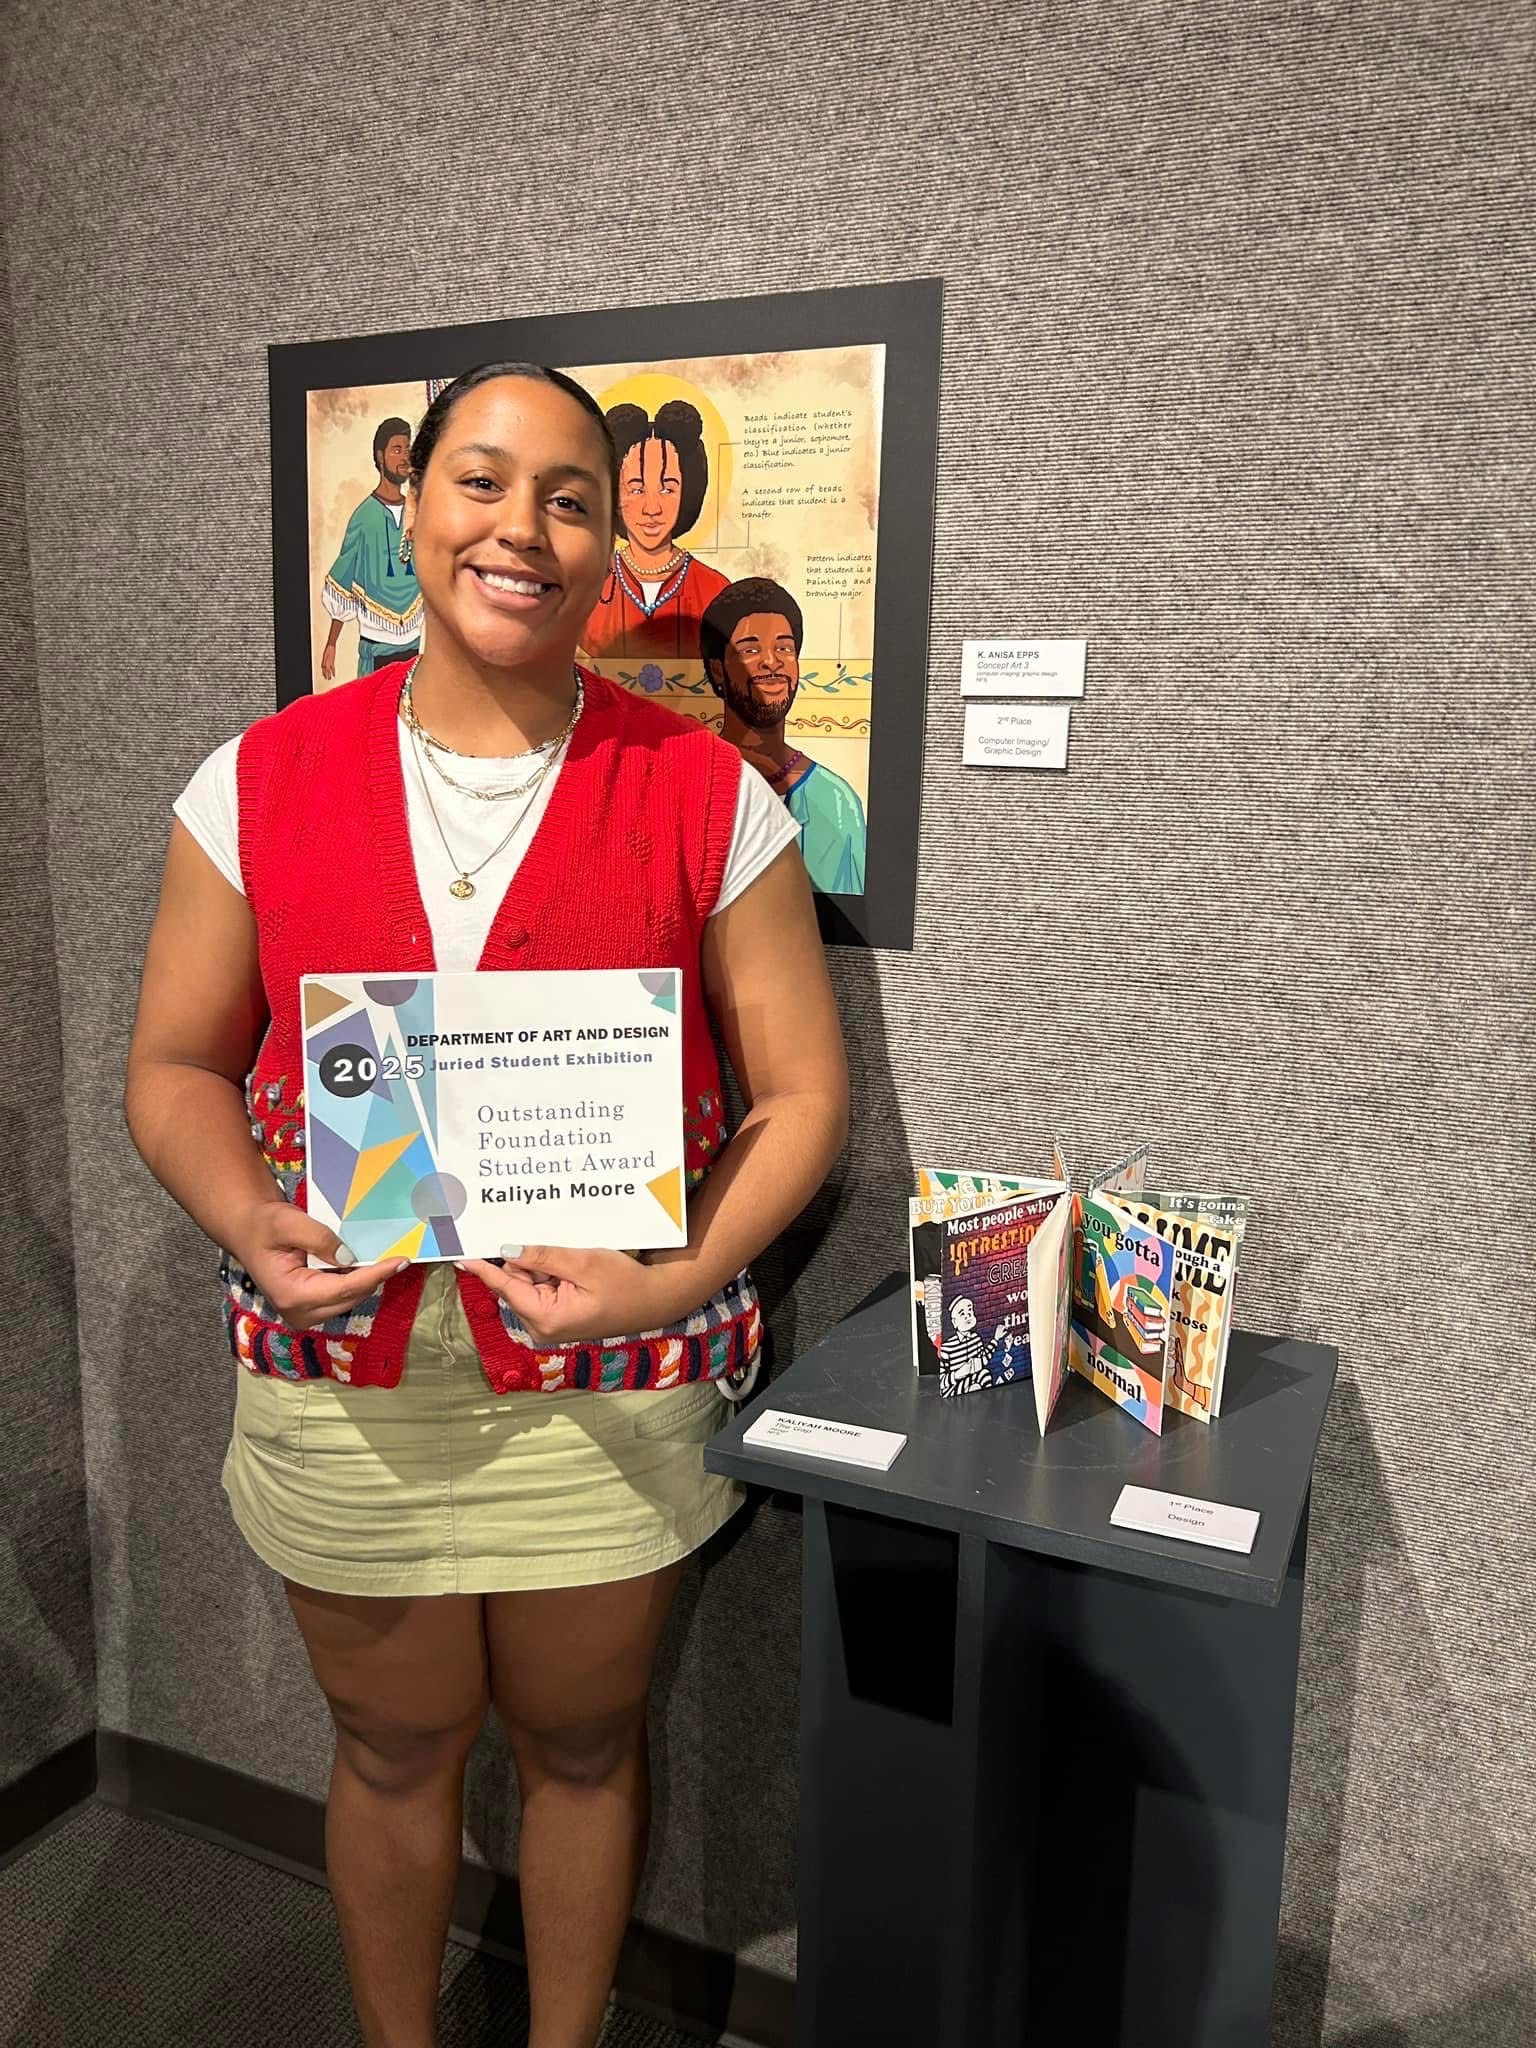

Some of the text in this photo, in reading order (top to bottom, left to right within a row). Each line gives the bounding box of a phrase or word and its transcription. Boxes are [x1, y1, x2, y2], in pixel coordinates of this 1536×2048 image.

[744, 409, 852, 422] Beads indicate student's
[744, 422, 852, 434] classification (whether
[744, 438, 769, 448] they're
[779, 434, 806, 447] junior,
[762, 448, 780, 457] Blue
[782, 446, 816, 456] indicates
[825, 444, 851, 456] junior
[754, 486, 782, 495] second
[805, 484, 815, 495] of
[818, 485, 842, 493] beads
[742, 498, 776, 507] indicates
[779, 498, 794, 506] that
[798, 496, 828, 505] student
[830, 496, 838, 504] is
[837, 553, 872, 562] indicates
[806, 566, 822, 574] that
[824, 566, 854, 574] student
[856, 564, 864, 572] is
[806, 576, 872, 588] Painting and
[806, 588, 838, 600] Drawing
[978, 651, 1040, 659] K. ANISA EPPS
[977, 662, 1030, 670] Concept Art 3
[1011, 717, 1032, 726] Place
[978, 736, 1050, 748] Computer Imaging/
[984, 747, 1042, 758] Graphic Design
[407, 1026, 670, 1047] DEPARTMENT OF ART AND DESIGN
[333, 1051, 653, 1082] 2025 Juried Student Exhibition
[478, 1101, 625, 1123] Outstanding
[478, 1128, 612, 1150] Foundation
[479, 1151, 656, 1176] Student Award
[481, 1182, 636, 1205] Kaliyah Moore
[911, 1199, 944, 1215] BUT
[1169, 1197, 1245, 1212] It's gonna
[947, 1199, 1054, 1236] Most people who
[1208, 1214, 1244, 1226] take
[1083, 1211, 1160, 1267] you gotta
[950, 1225, 1039, 1268] INTRESTIN
[1212, 1262, 1221, 1273] a
[1087, 1351, 1142, 1404] normal
[776, 1422, 791, 1430] The
[778, 1417, 862, 1437] KALIYAH MOORE
[1184, 1503, 1214, 1515] Place
[1168, 1514, 1205, 1526] Design
